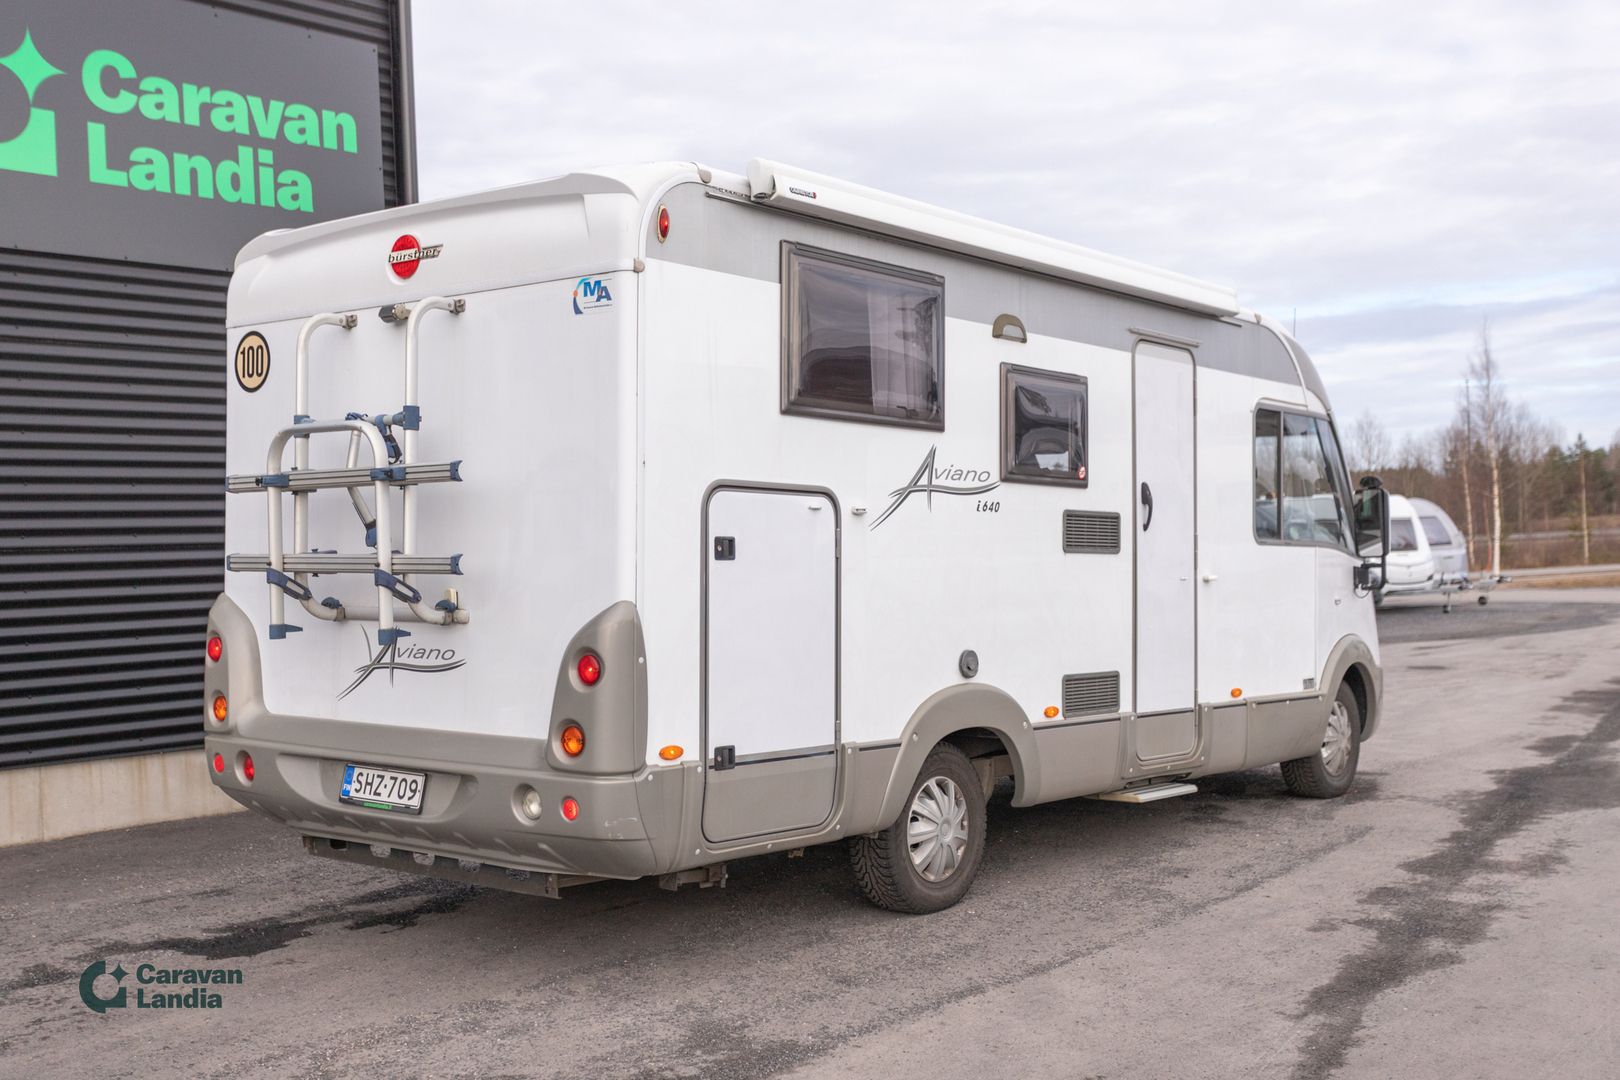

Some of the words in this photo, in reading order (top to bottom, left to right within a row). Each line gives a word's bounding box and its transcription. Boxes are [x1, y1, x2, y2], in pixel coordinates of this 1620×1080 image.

[81, 49, 358, 154] Caravan
[87, 121, 314, 213] Landia
[583, 279, 612, 302] MA
[240, 344, 264, 379] 100
[867, 443, 1001, 532] Aviano
[336, 625, 467, 702] Aviano
[353, 771, 419, 801] SHZ-709
